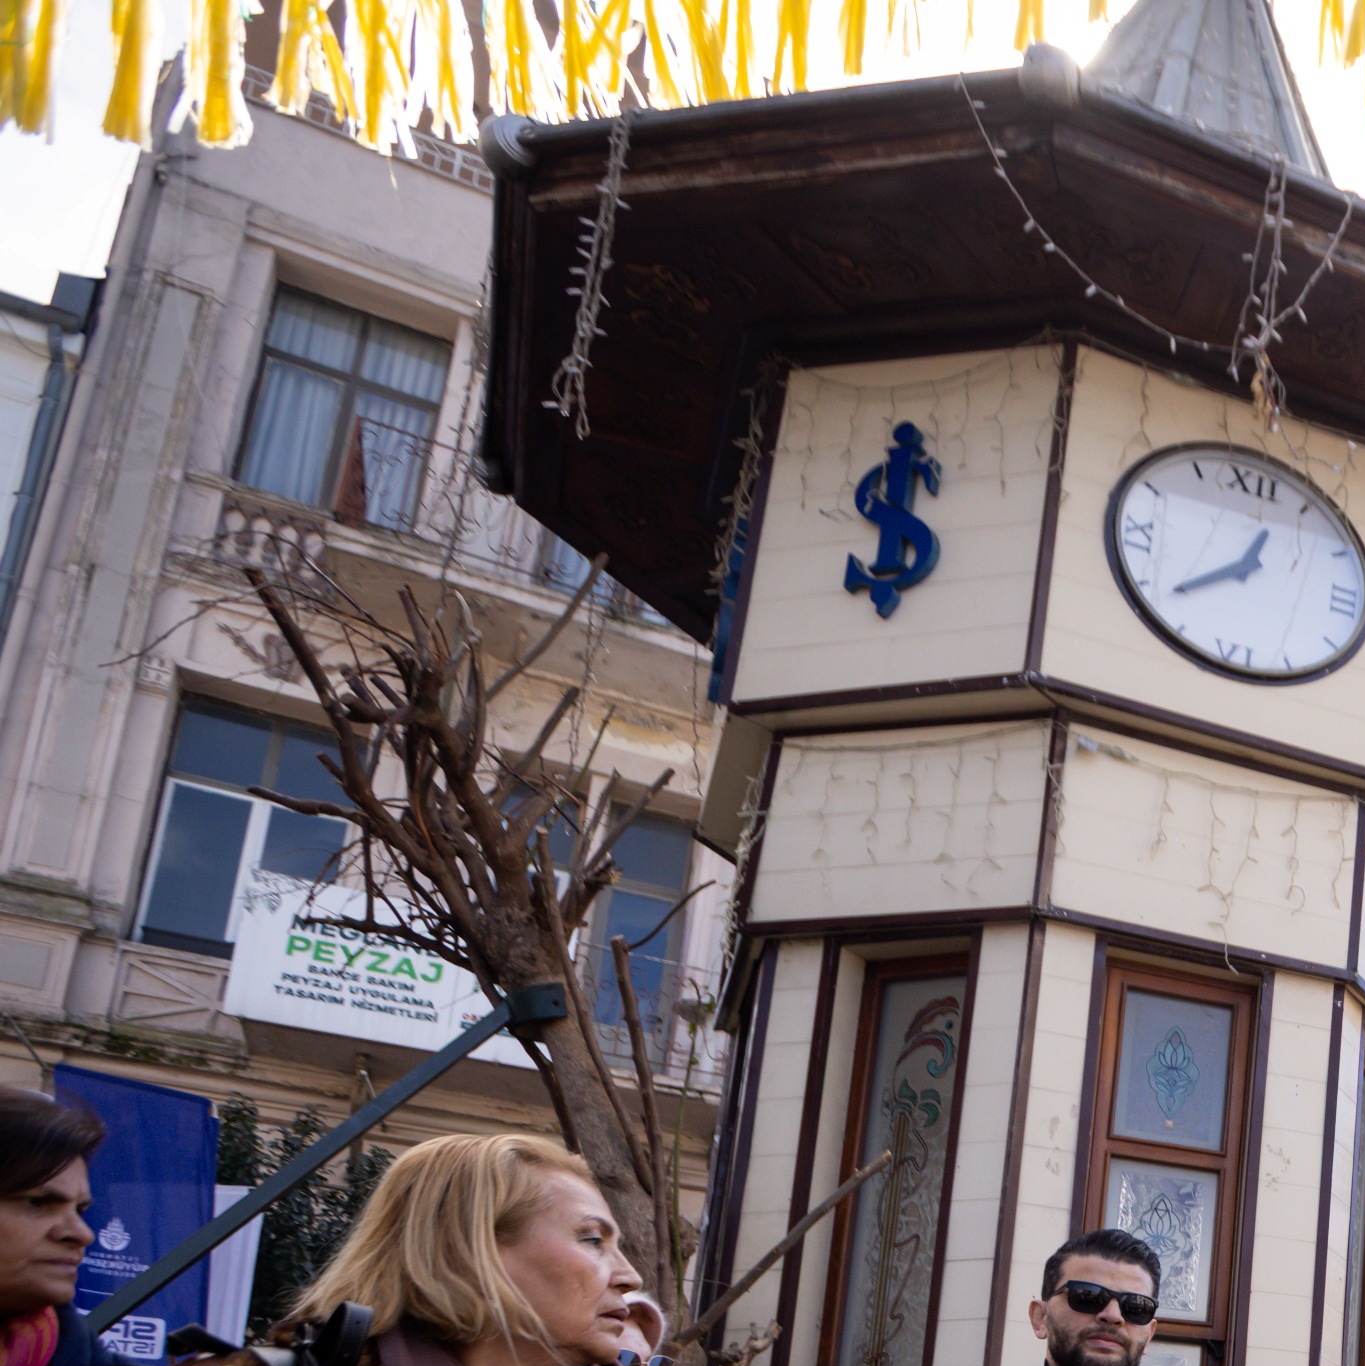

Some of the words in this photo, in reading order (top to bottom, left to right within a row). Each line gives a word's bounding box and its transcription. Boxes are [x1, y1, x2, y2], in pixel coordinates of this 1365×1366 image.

[1226, 464, 1280, 502] XII
[1124, 514, 1154, 554] IX
[1330, 583, 1358, 619] III
[285, 934, 444, 985] PEYZAJ
[280, 972, 343, 992] PEYZAJ
[349, 986, 434, 1010] UYGULAMA
[366, 975, 415, 992] BAKIM
[273, 984, 345, 1006] TASARIM
[350, 998, 438, 1023] HİZMETLERİ
